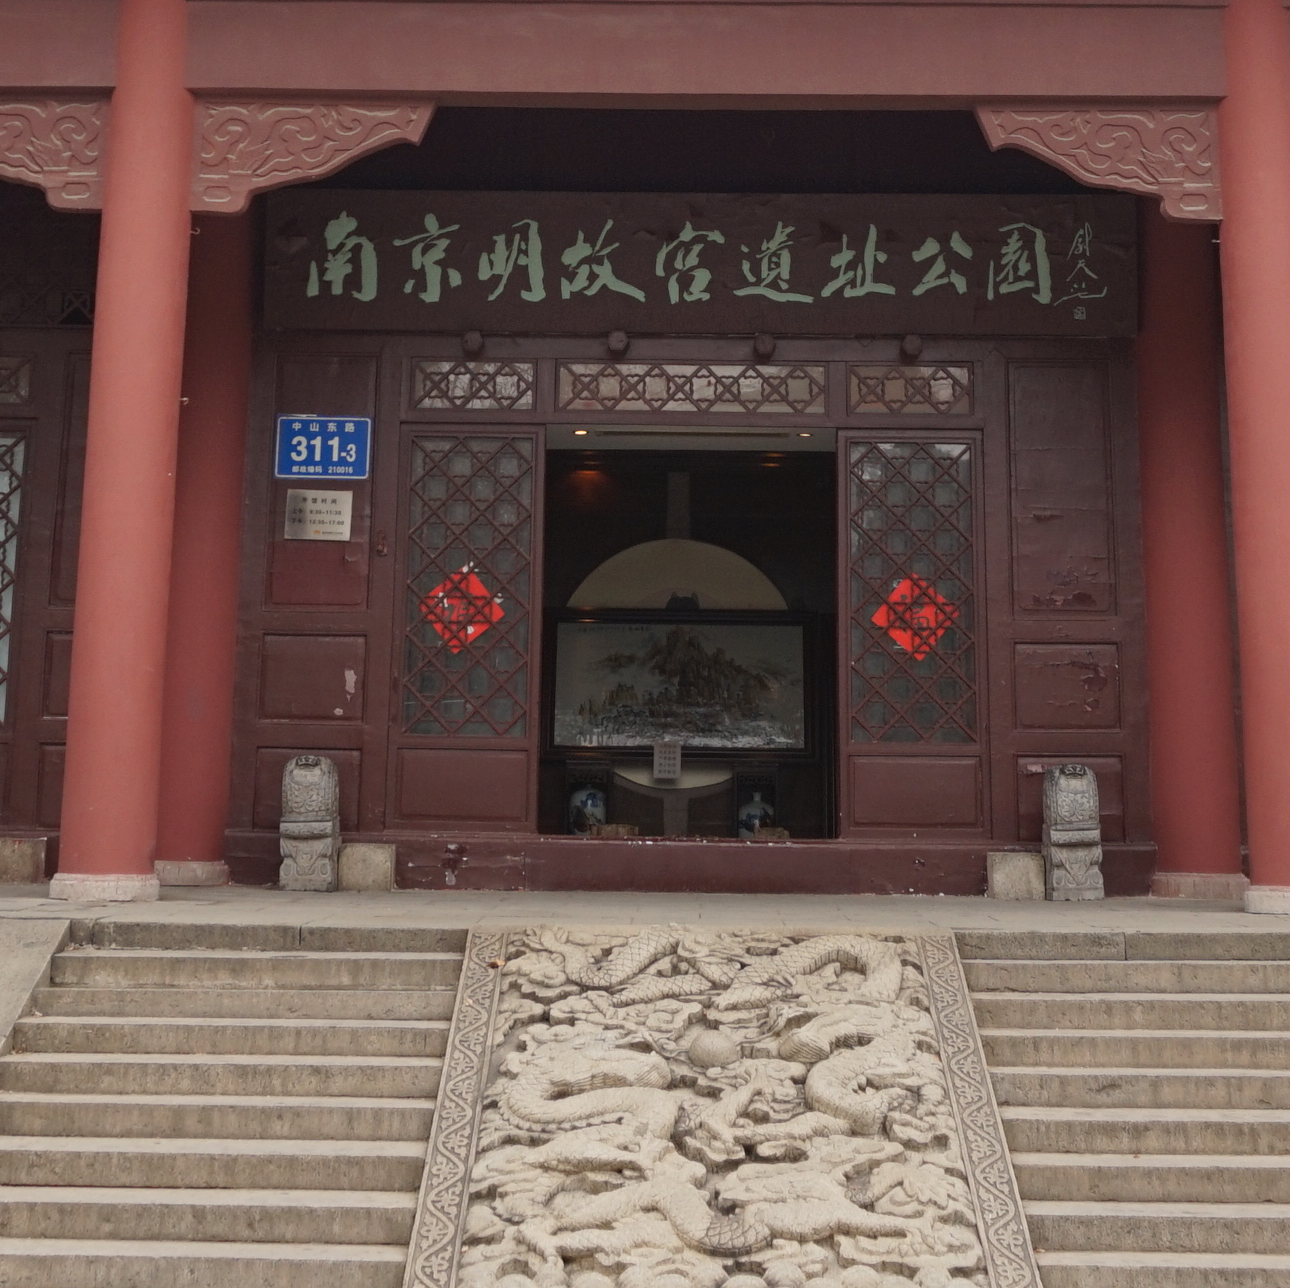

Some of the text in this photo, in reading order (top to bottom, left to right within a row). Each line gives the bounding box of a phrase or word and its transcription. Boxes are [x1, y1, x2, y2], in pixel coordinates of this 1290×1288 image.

[291, 421, 355, 433] 中山东路
[290, 435, 356, 463] 311-3
